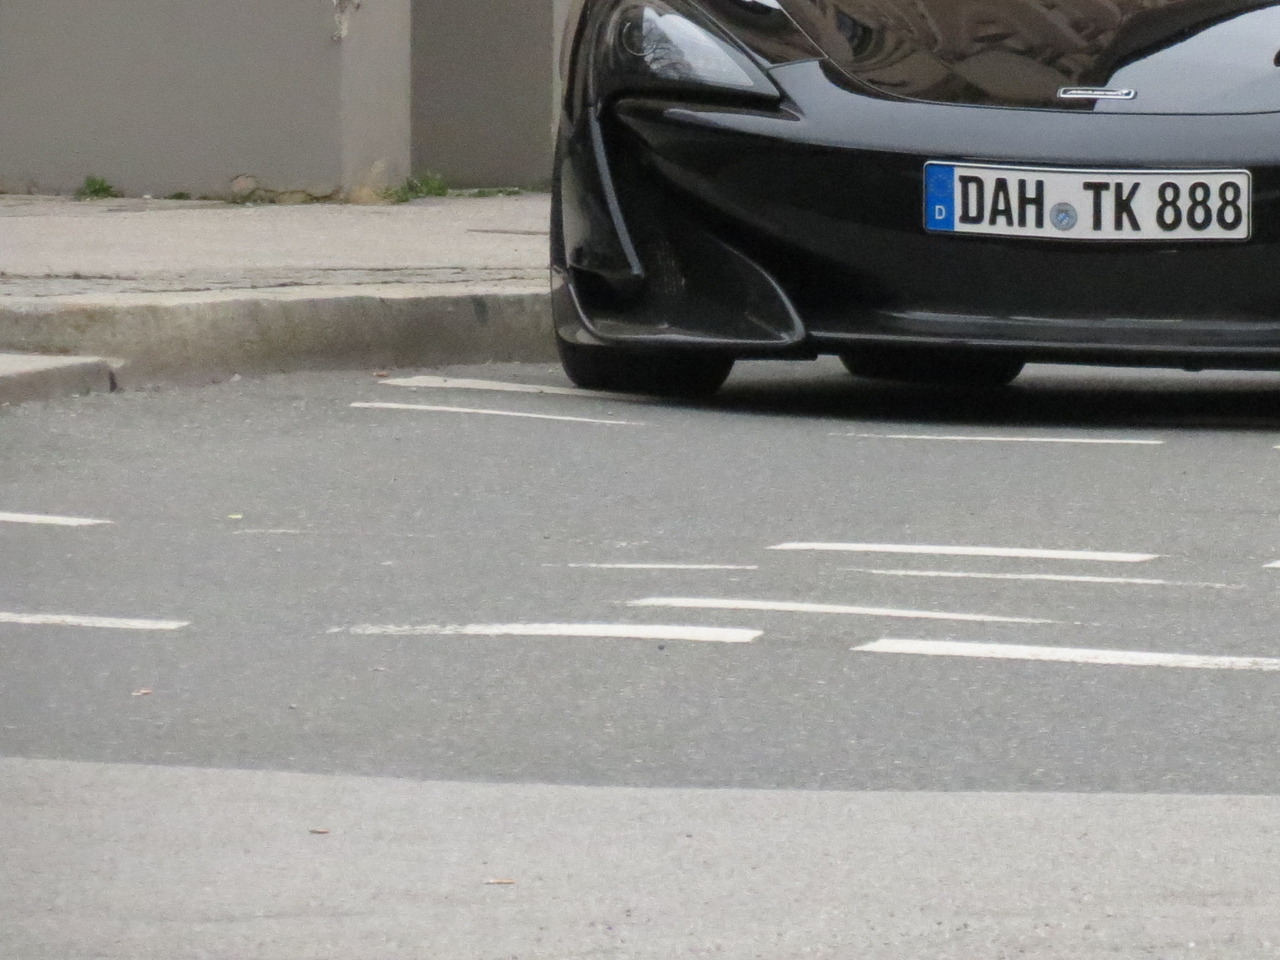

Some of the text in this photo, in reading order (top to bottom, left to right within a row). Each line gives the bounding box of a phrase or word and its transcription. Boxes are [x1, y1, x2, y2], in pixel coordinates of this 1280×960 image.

[934, 204, 946, 220] D
[958, 174, 1242, 232] DAH TK 888
